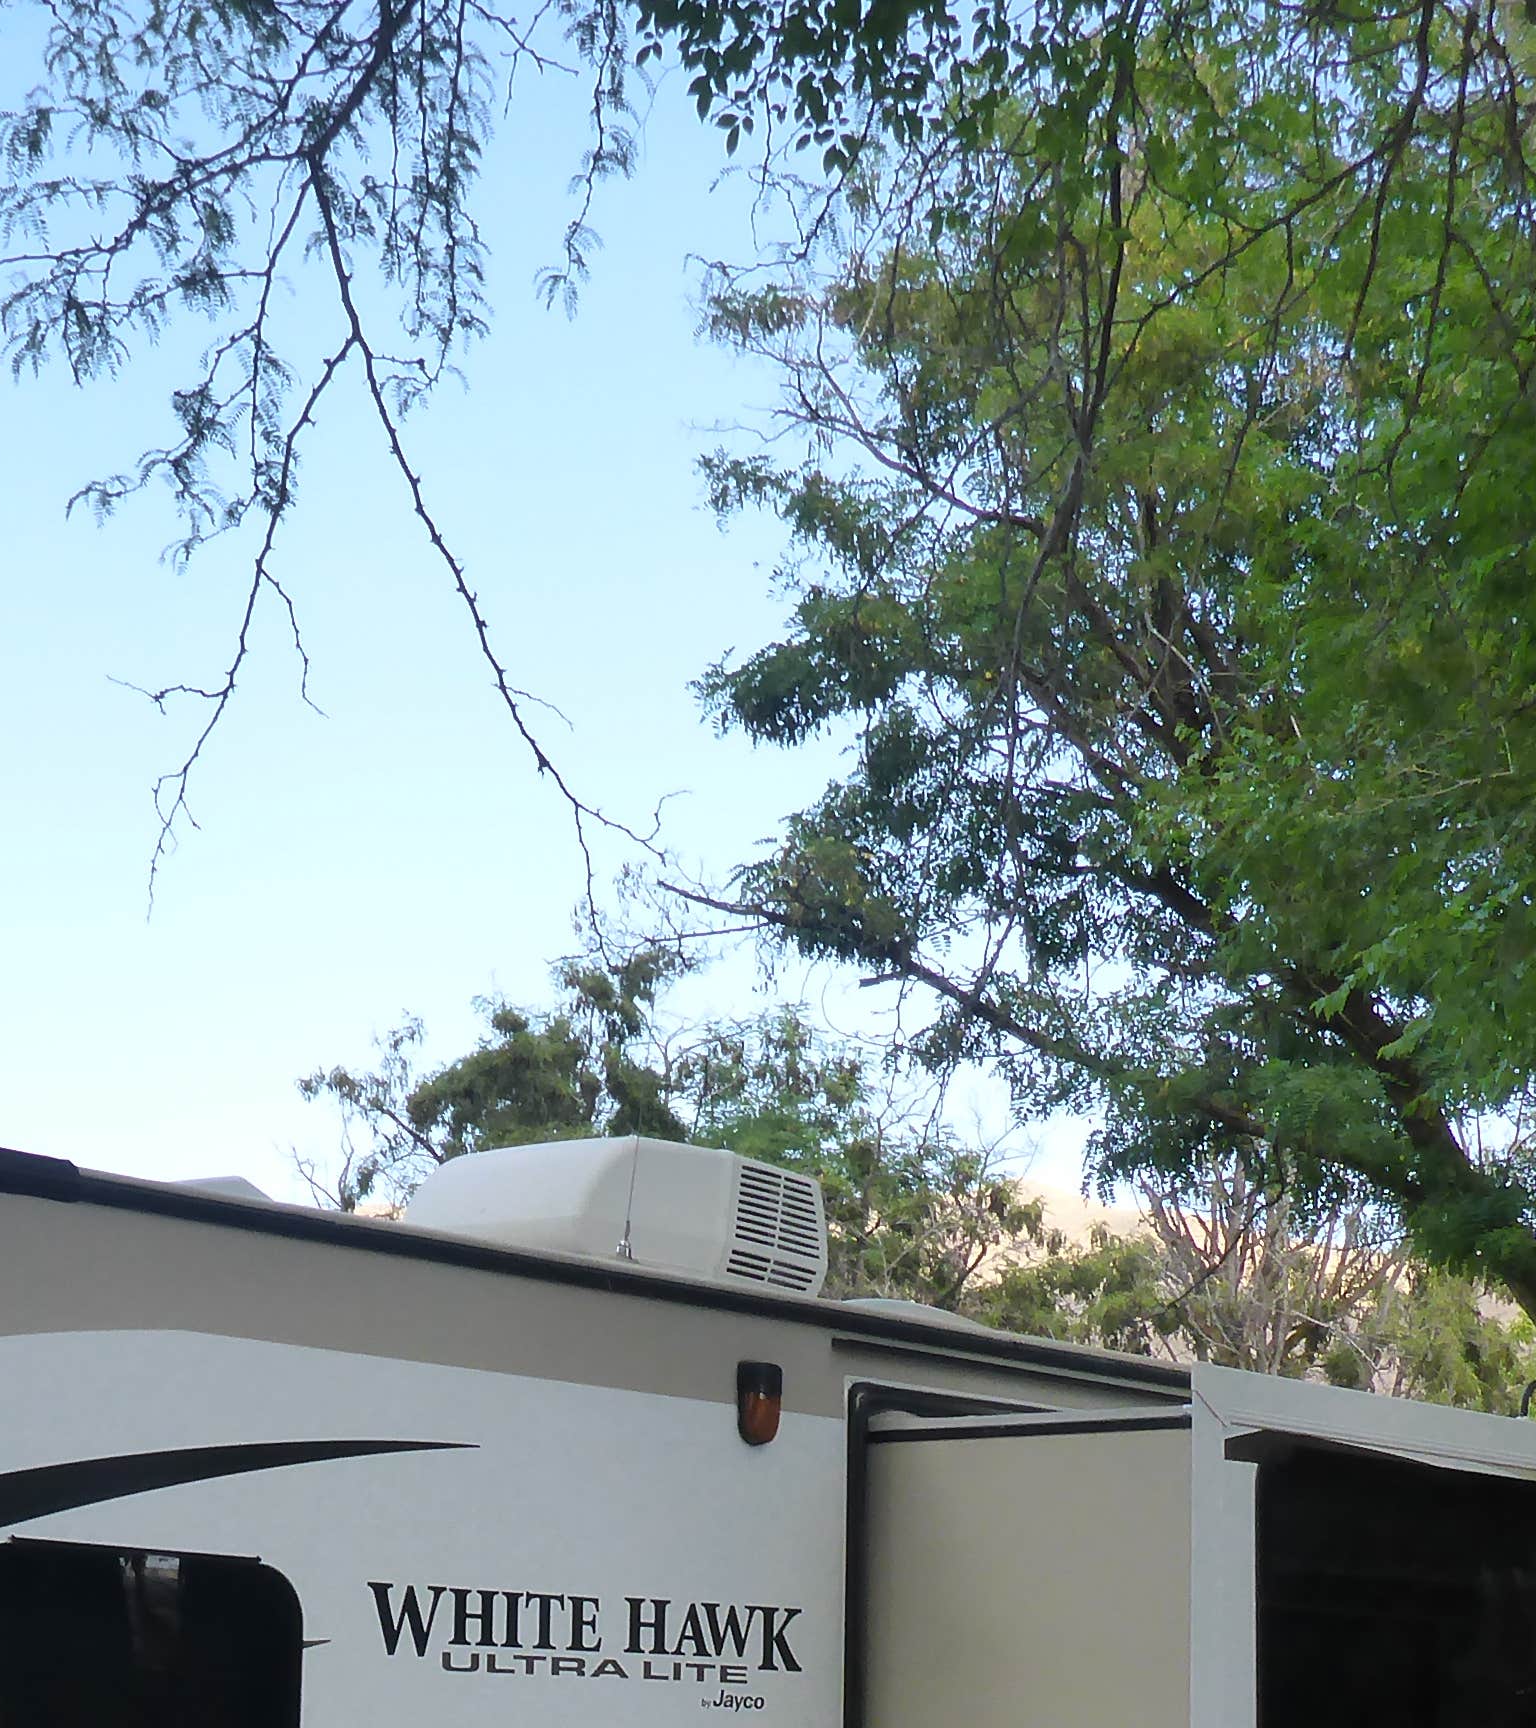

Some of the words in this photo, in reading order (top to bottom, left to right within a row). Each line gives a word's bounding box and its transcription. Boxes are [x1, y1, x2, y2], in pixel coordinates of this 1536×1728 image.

[367, 1580, 603, 1658] WHITE
[623, 1597, 803, 1673] HAWK
[441, 1651, 629, 1679] ULTRA
[643, 1660, 749, 1685] LITE
[700, 1698, 712, 1710] by
[713, 1689, 765, 1713] Jayco
